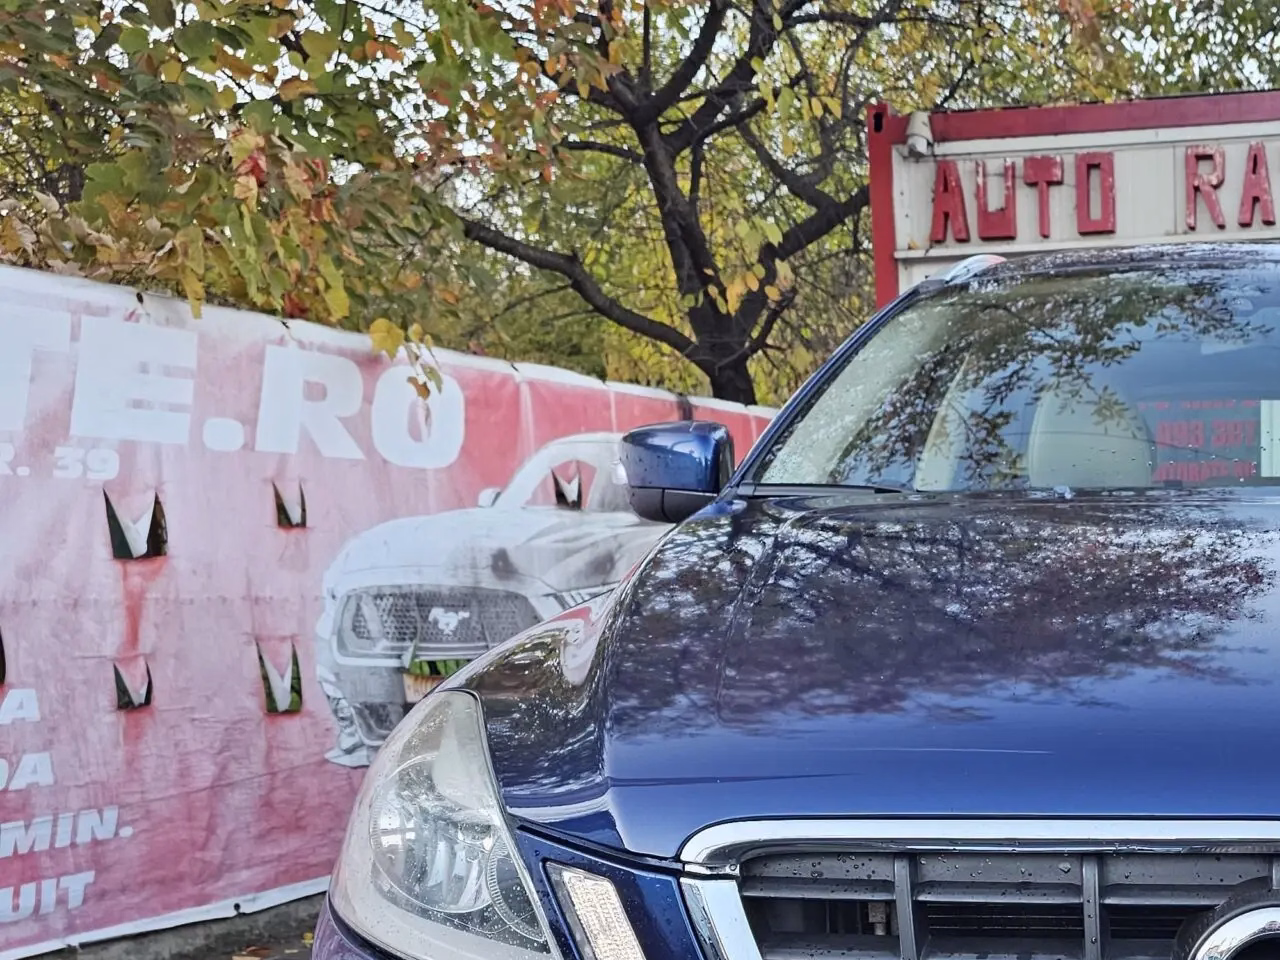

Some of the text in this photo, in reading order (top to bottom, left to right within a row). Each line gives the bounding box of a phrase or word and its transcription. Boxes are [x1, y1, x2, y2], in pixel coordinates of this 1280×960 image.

[930, 151, 1116, 242] AUTO
[53, 446, 120, 480] 39
[0, 751, 55, 792] A
[0, 805, 135, 859] MIN.
